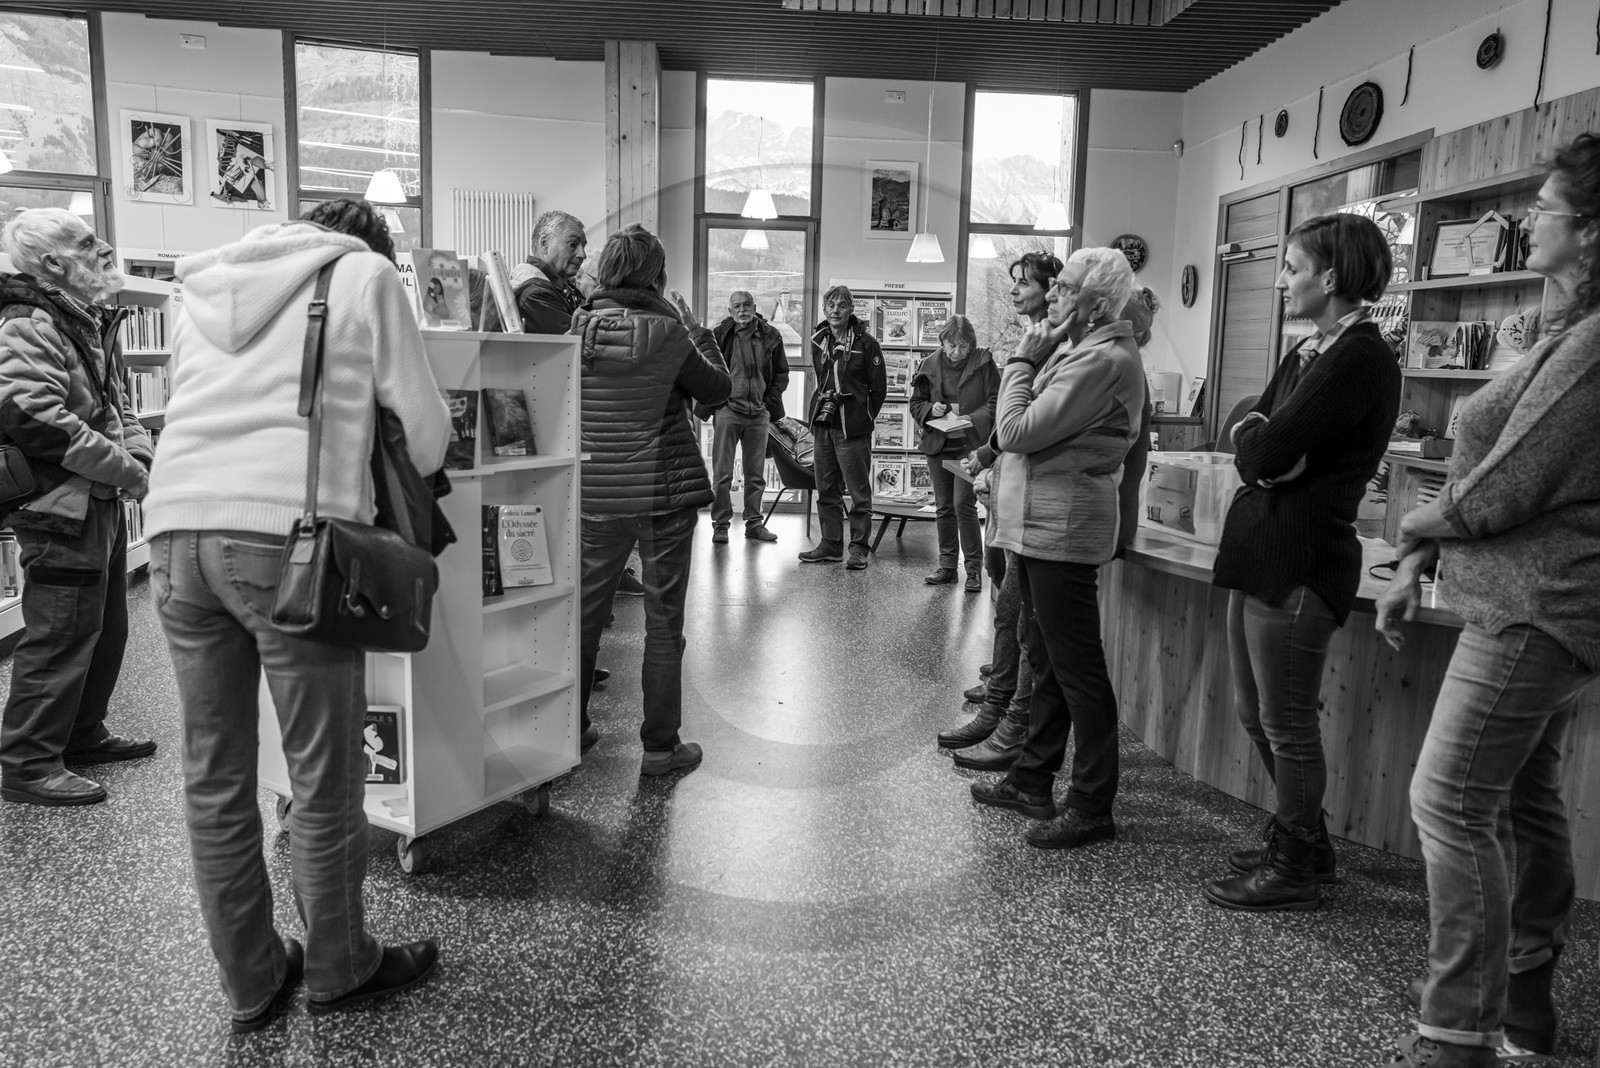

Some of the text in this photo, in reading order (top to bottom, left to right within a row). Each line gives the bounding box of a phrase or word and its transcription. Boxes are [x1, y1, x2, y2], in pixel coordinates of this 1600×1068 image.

[502, 519, 538, 530] L'Odyssée
[506, 528, 536, 537] du sacré
